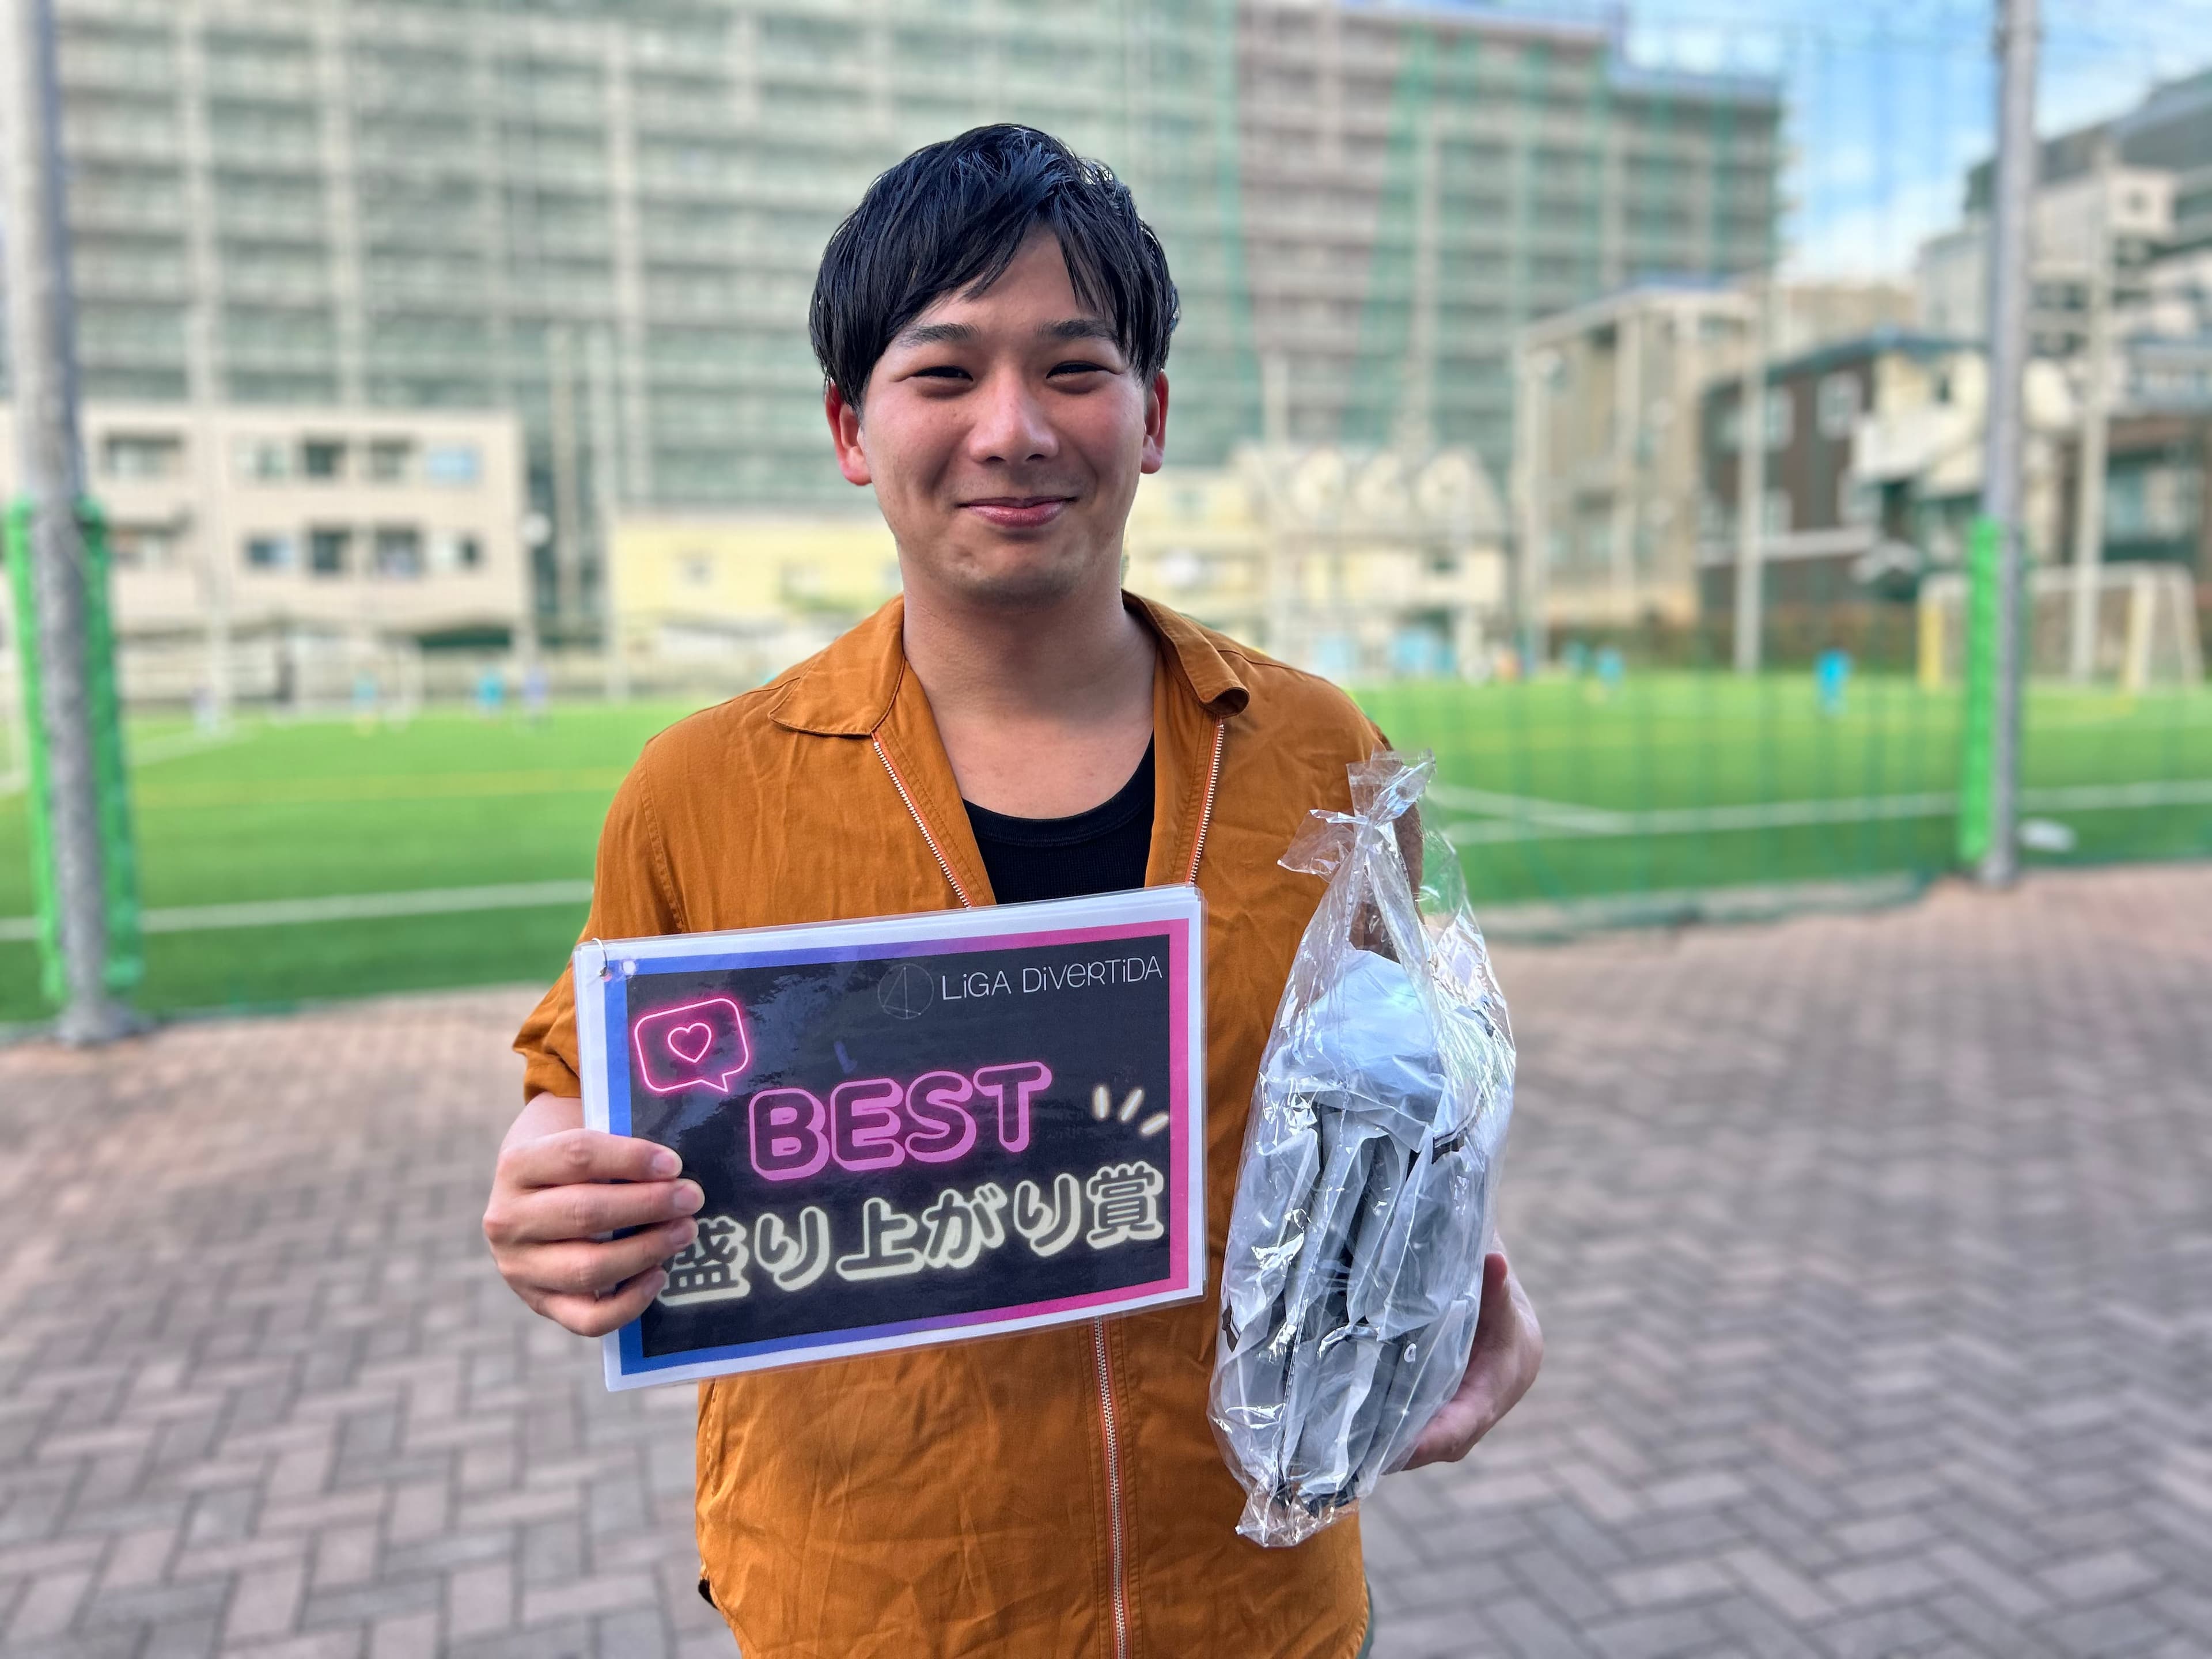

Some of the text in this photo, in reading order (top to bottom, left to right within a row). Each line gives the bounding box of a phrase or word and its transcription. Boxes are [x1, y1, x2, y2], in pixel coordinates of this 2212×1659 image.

[749, 1061, 1052, 1181] BEST
[657, 1160, 1164, 1307] 盛り上がり賞
